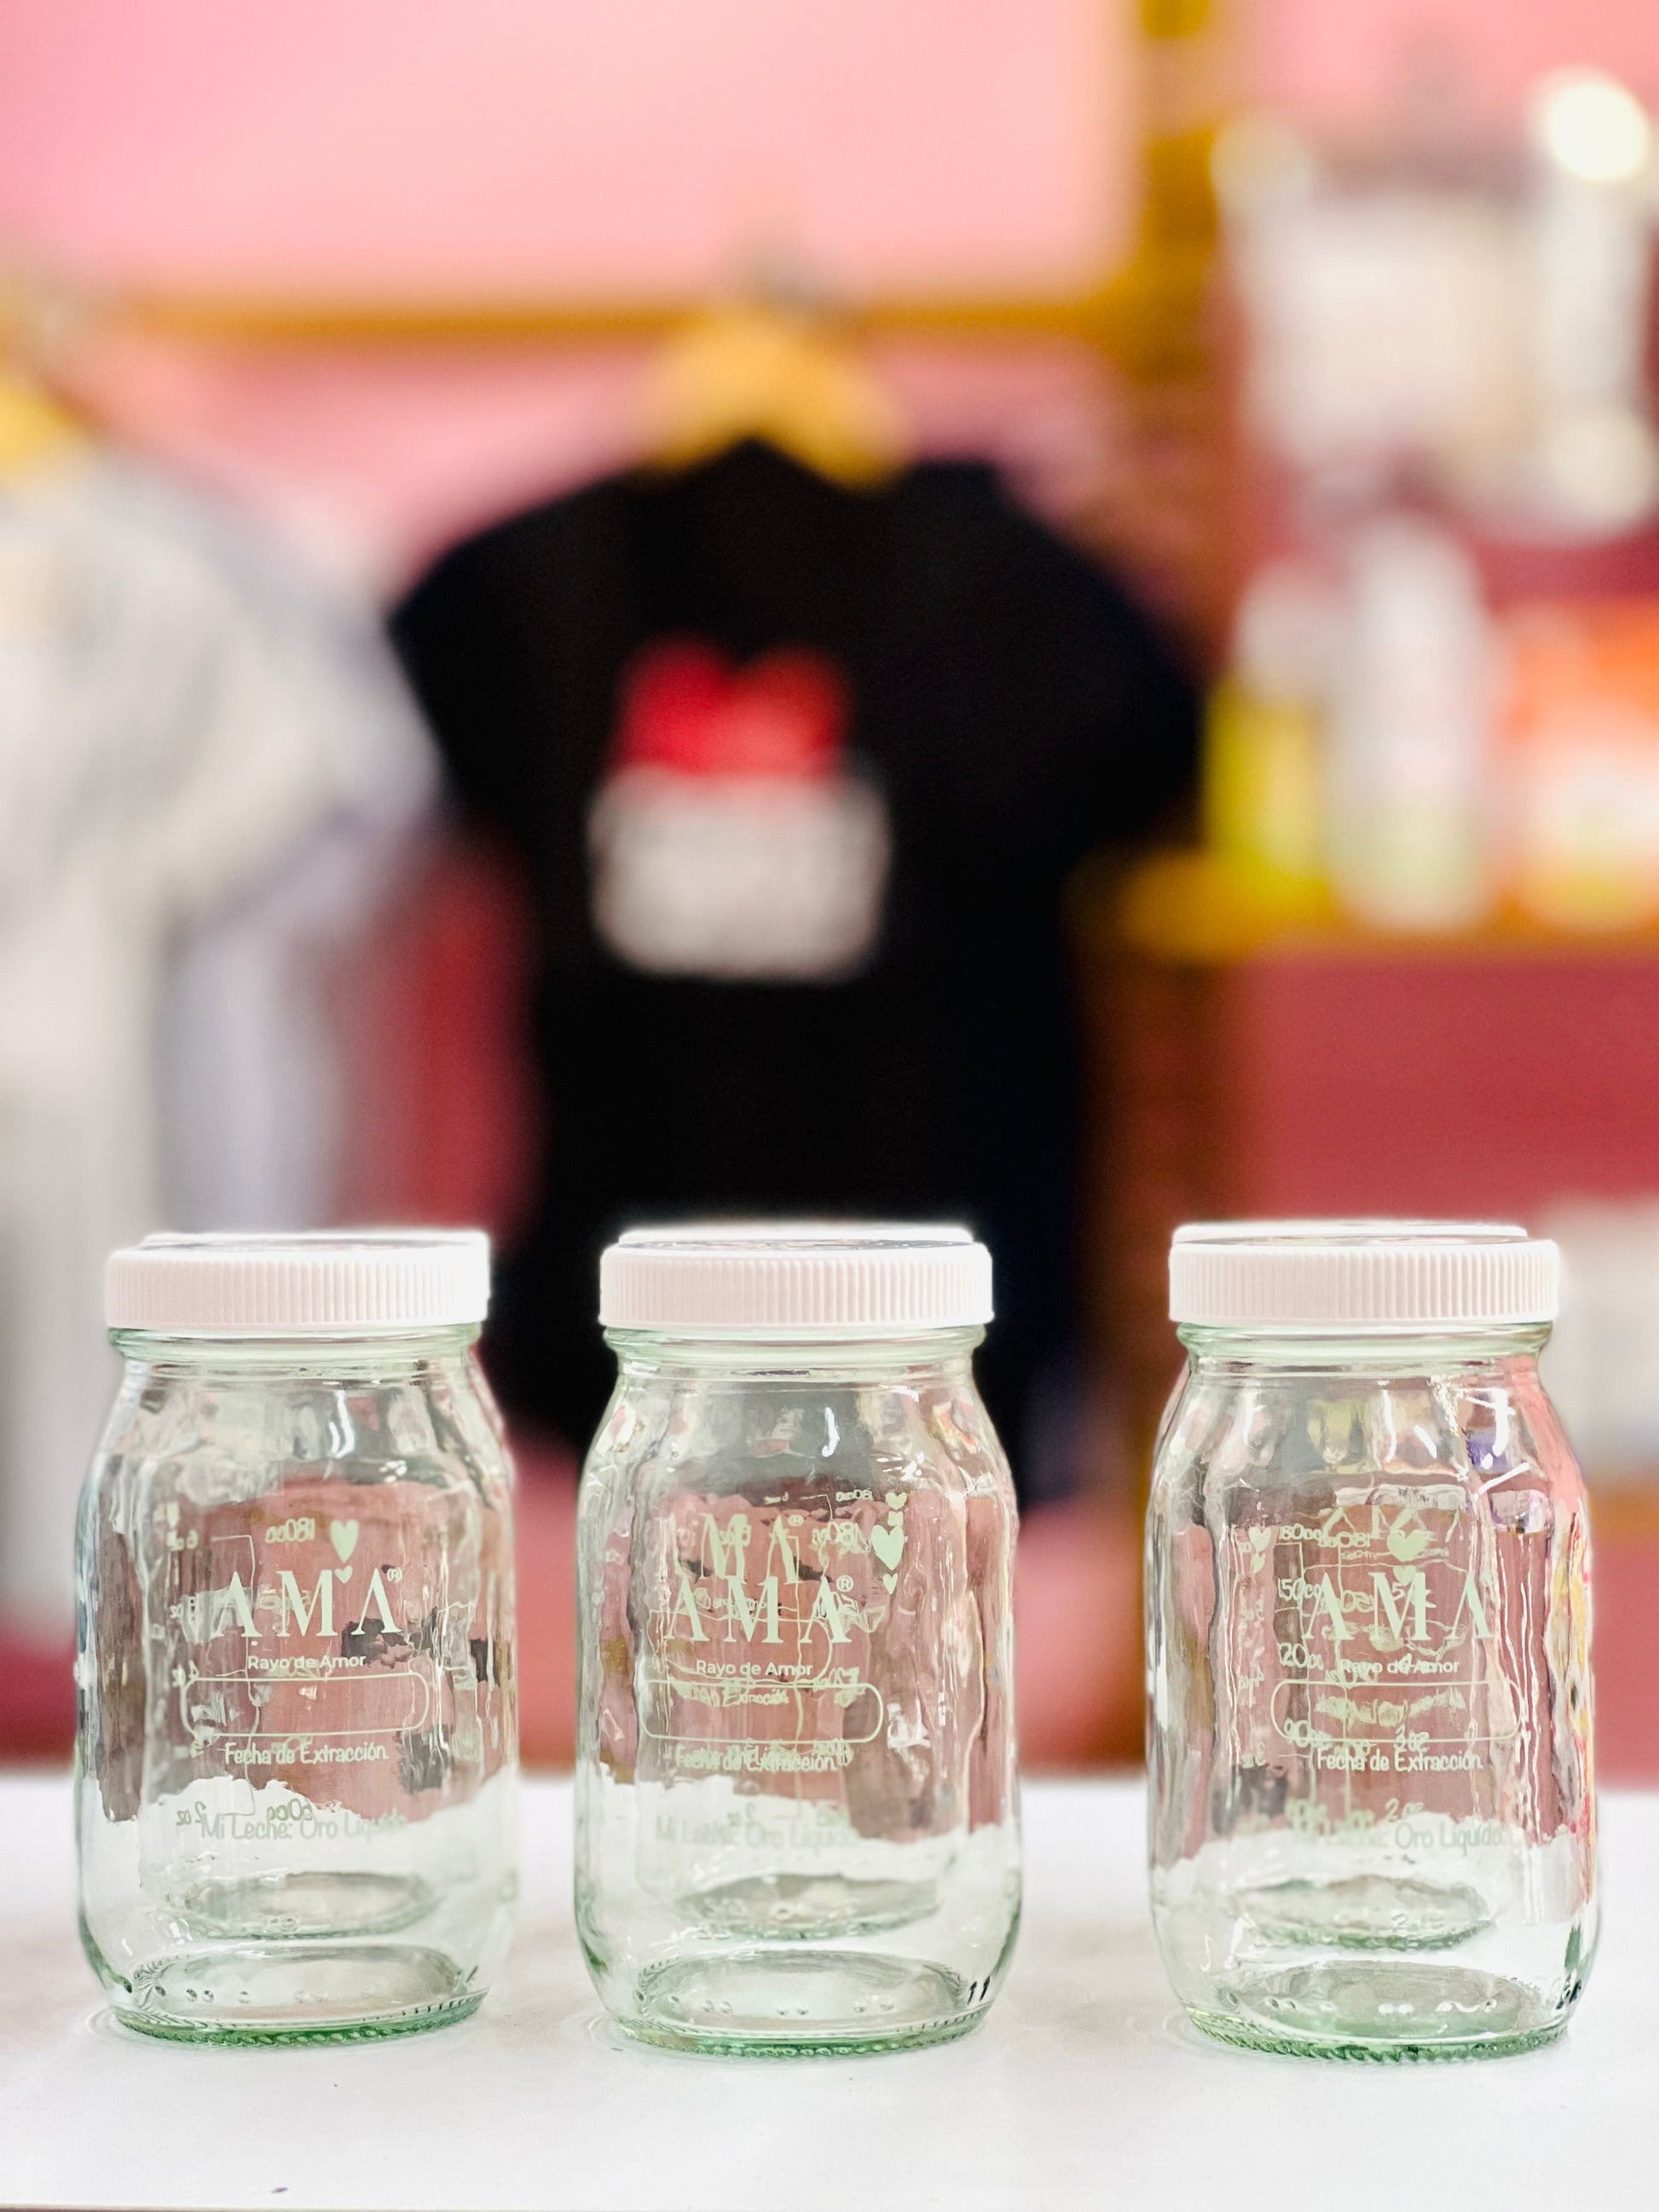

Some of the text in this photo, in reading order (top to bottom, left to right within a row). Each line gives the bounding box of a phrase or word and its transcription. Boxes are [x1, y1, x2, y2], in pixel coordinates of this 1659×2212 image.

[248, 1655, 290, 1670] Rayo
[320, 1655, 367, 1668] Amor
[696, 1660, 813, 1677] Rayo de Amor
[224, 1742, 271, 1764] Fecha
[1317, 1747, 1366, 1771] Fecha
[1369, 1748, 1390, 1771] de
[300, 1815, 338, 1839] Oro
[1395, 1822, 1435, 1849] Oro
